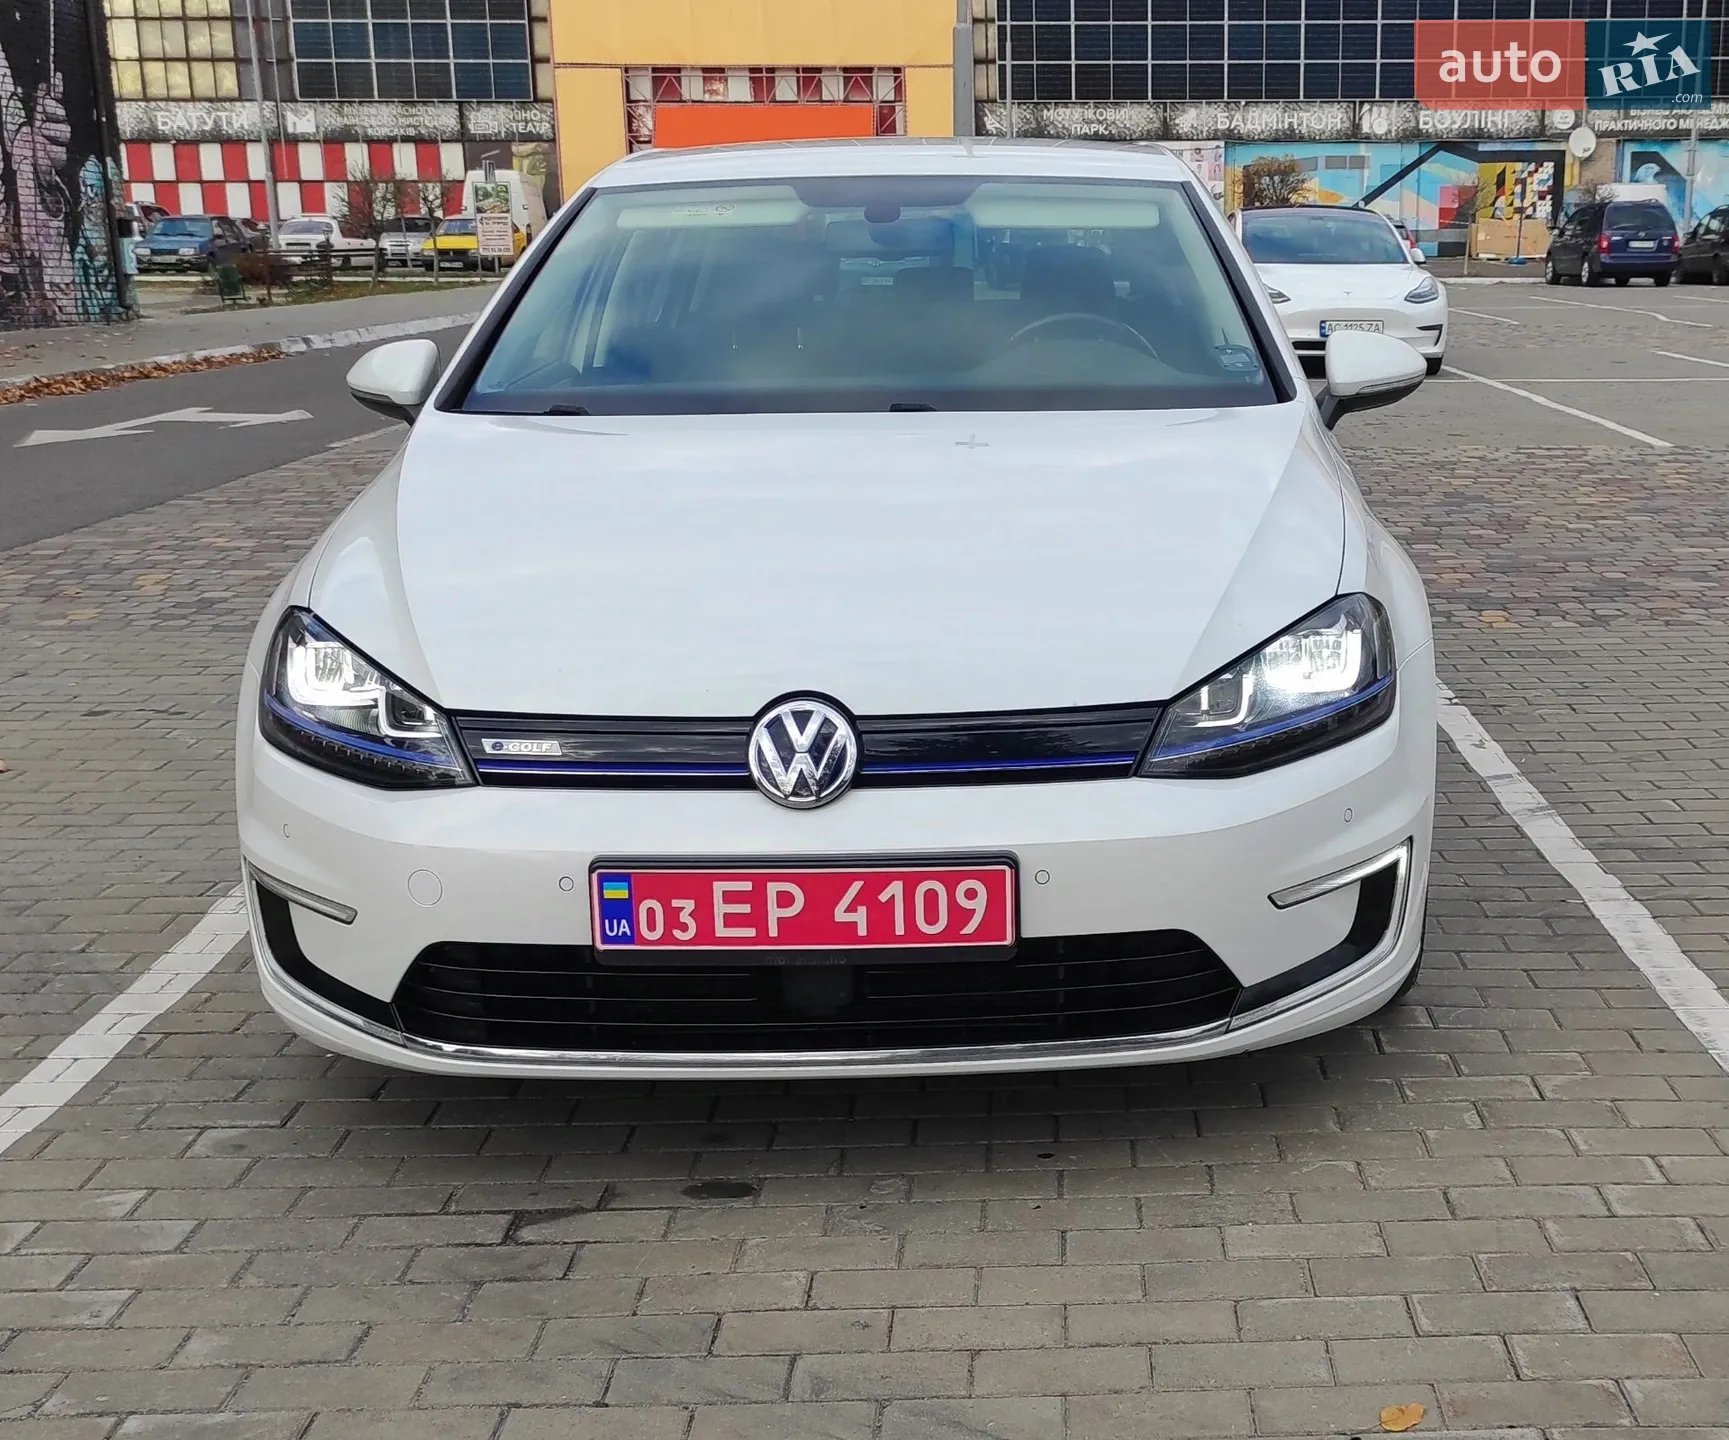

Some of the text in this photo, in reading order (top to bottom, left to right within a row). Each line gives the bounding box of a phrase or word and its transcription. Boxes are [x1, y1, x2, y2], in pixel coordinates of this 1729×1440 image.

[156, 109, 249, 131] БАТУТИ
[509, 121, 549, 135] ТЕАТР
[1071, 123, 1109, 135] ПАРК
[1217, 110, 1342, 132] БАДМІНТОН
[1594, 118, 1678, 132] ПРАКТИЧНОГО
[638, 879, 988, 941] 03 EP 4109
[604, 918, 631, 937] UA
